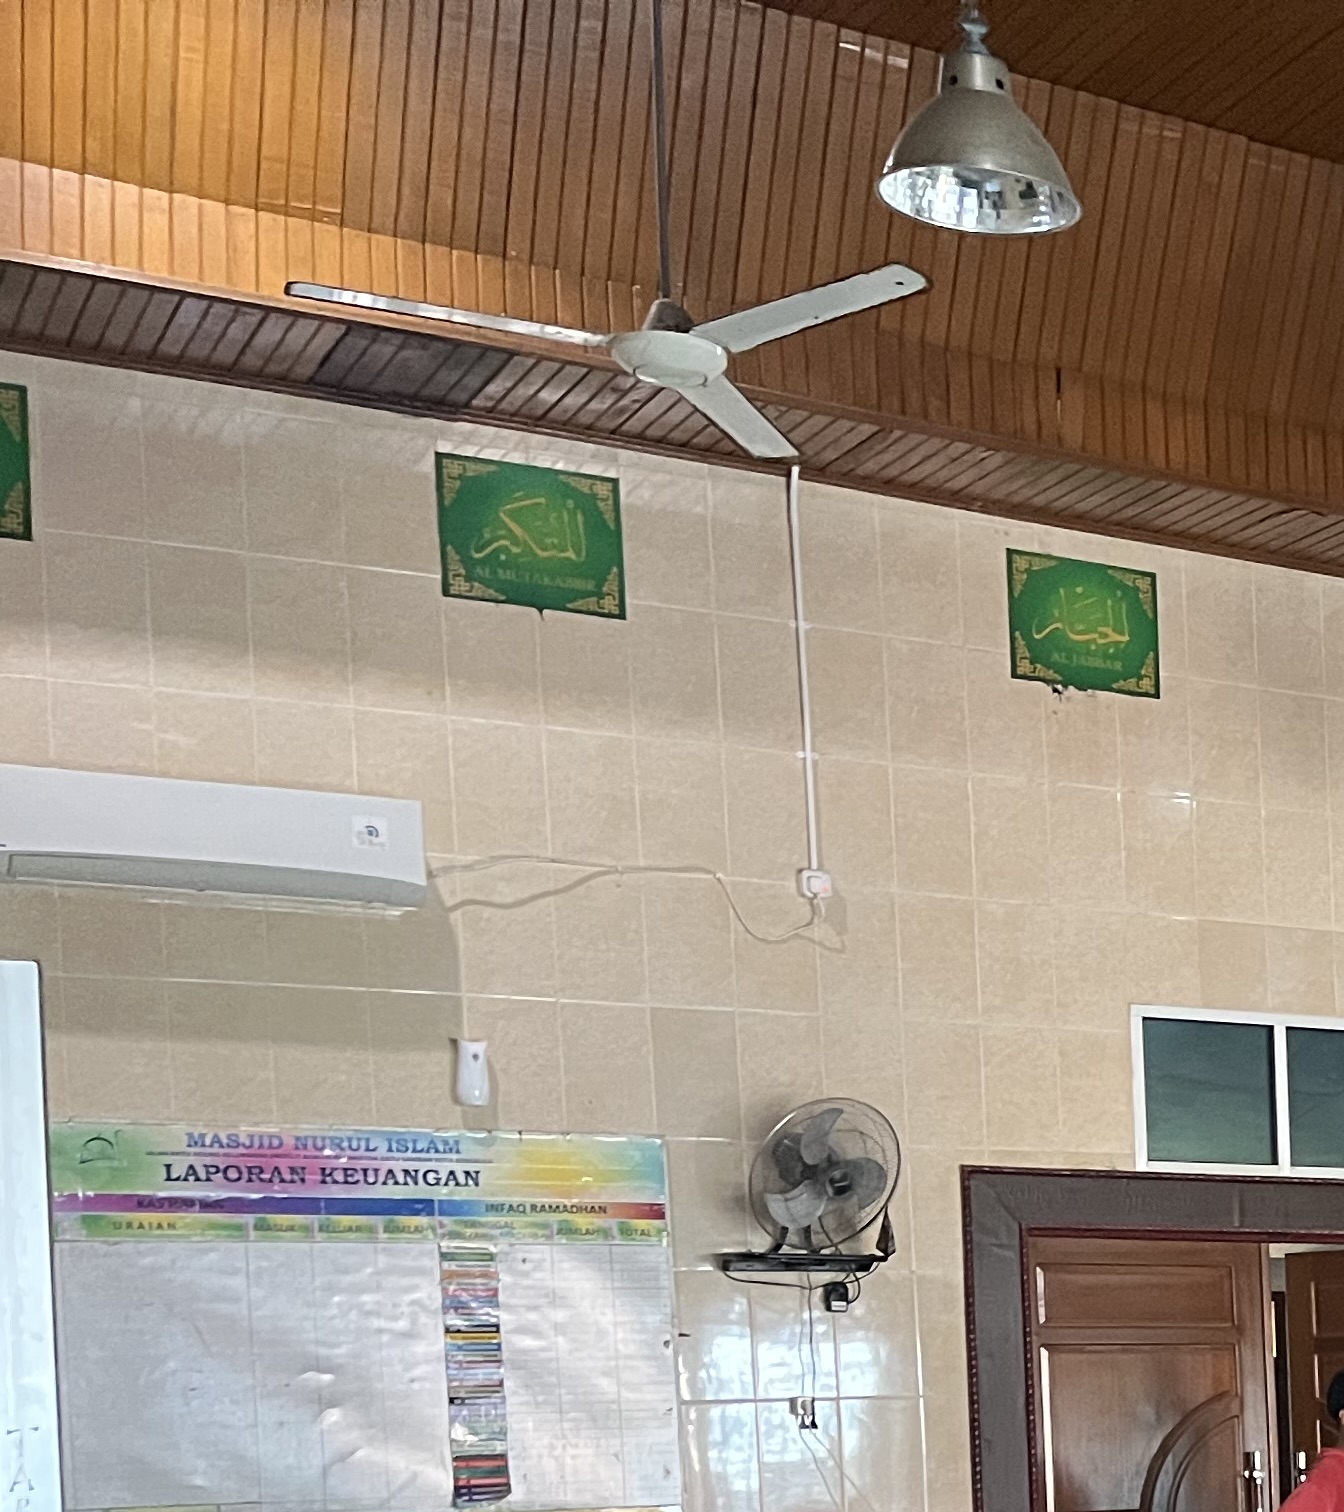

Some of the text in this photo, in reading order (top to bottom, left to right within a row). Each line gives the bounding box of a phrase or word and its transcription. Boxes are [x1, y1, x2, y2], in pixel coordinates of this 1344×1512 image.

[185, 1132, 463, 1155] MASJID NURUL ISLAM
[163, 1163, 481, 1188] LAPORAN KEUANGAN
[485, 1203, 608, 1215] INFAQ RAMADHAN
